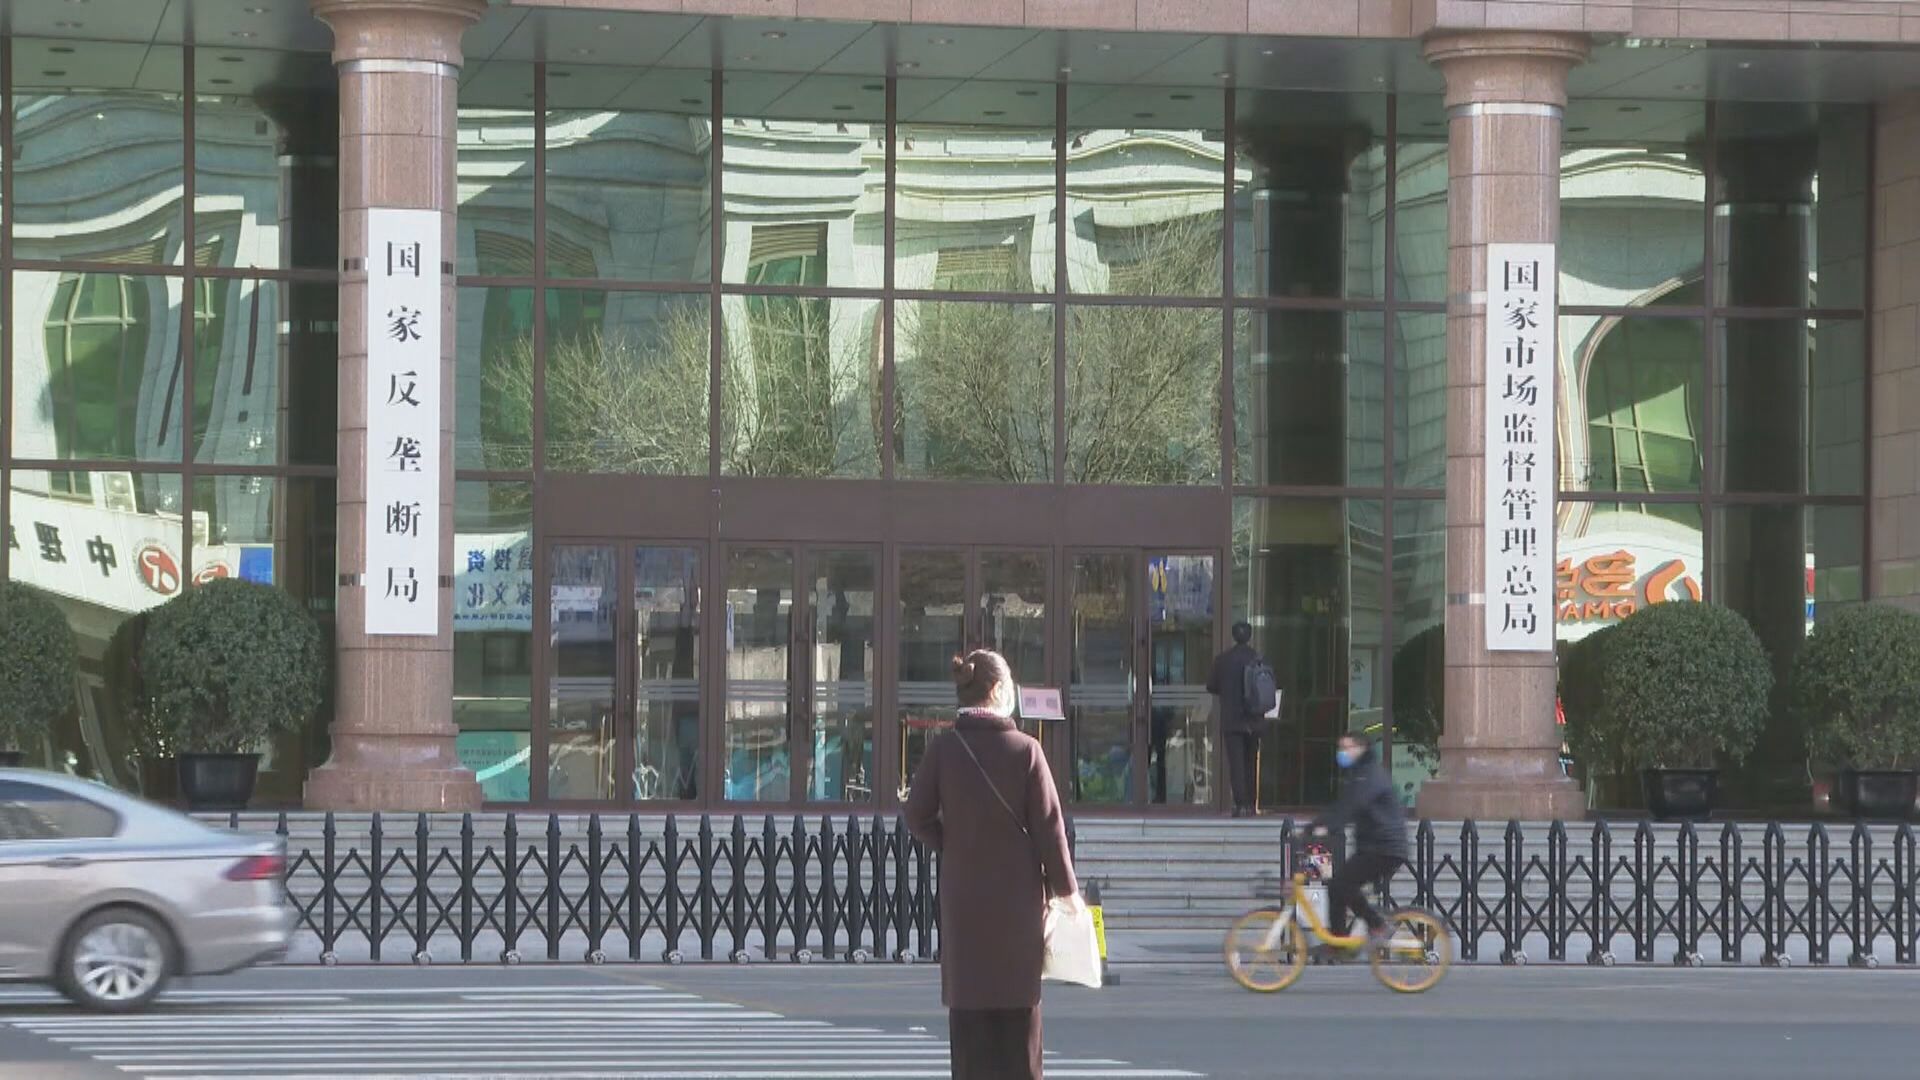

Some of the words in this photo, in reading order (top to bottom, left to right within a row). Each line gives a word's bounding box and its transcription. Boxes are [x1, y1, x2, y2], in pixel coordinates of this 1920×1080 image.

[385, 241, 422, 603] 国家反垄断局
[1502, 260, 1540, 635] 国家市场监督管理总局
